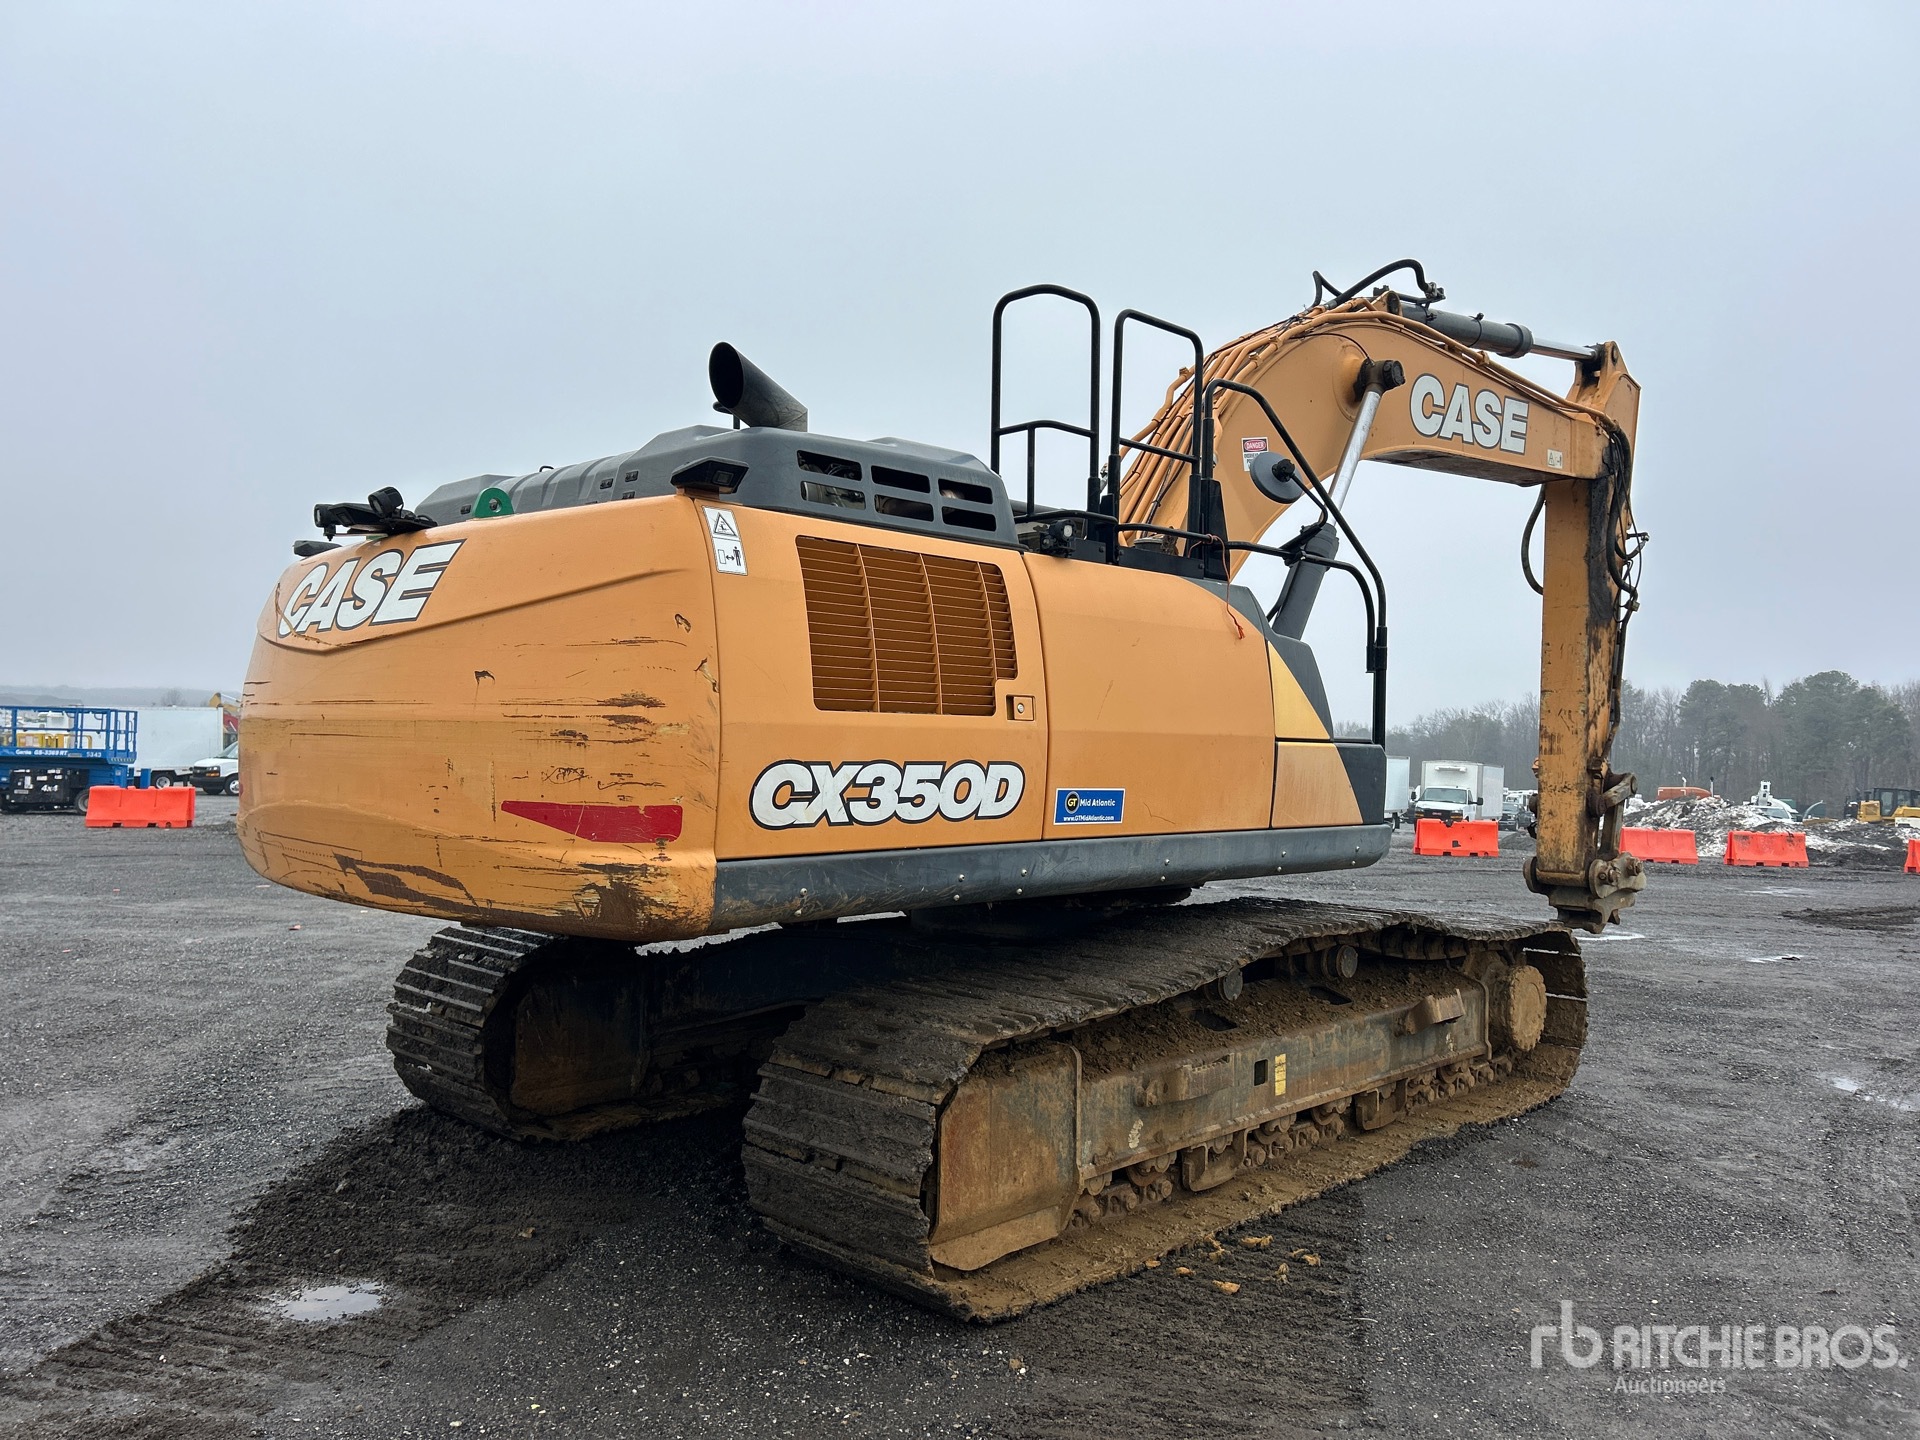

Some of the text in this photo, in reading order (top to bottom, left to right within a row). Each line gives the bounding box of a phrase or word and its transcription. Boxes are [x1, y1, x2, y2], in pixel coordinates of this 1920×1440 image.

[1410, 373, 1529, 455] CASE
[278, 538, 466, 638] CASE
[749, 760, 1025, 830] CX350D
[1068, 798, 1077, 806] GT
